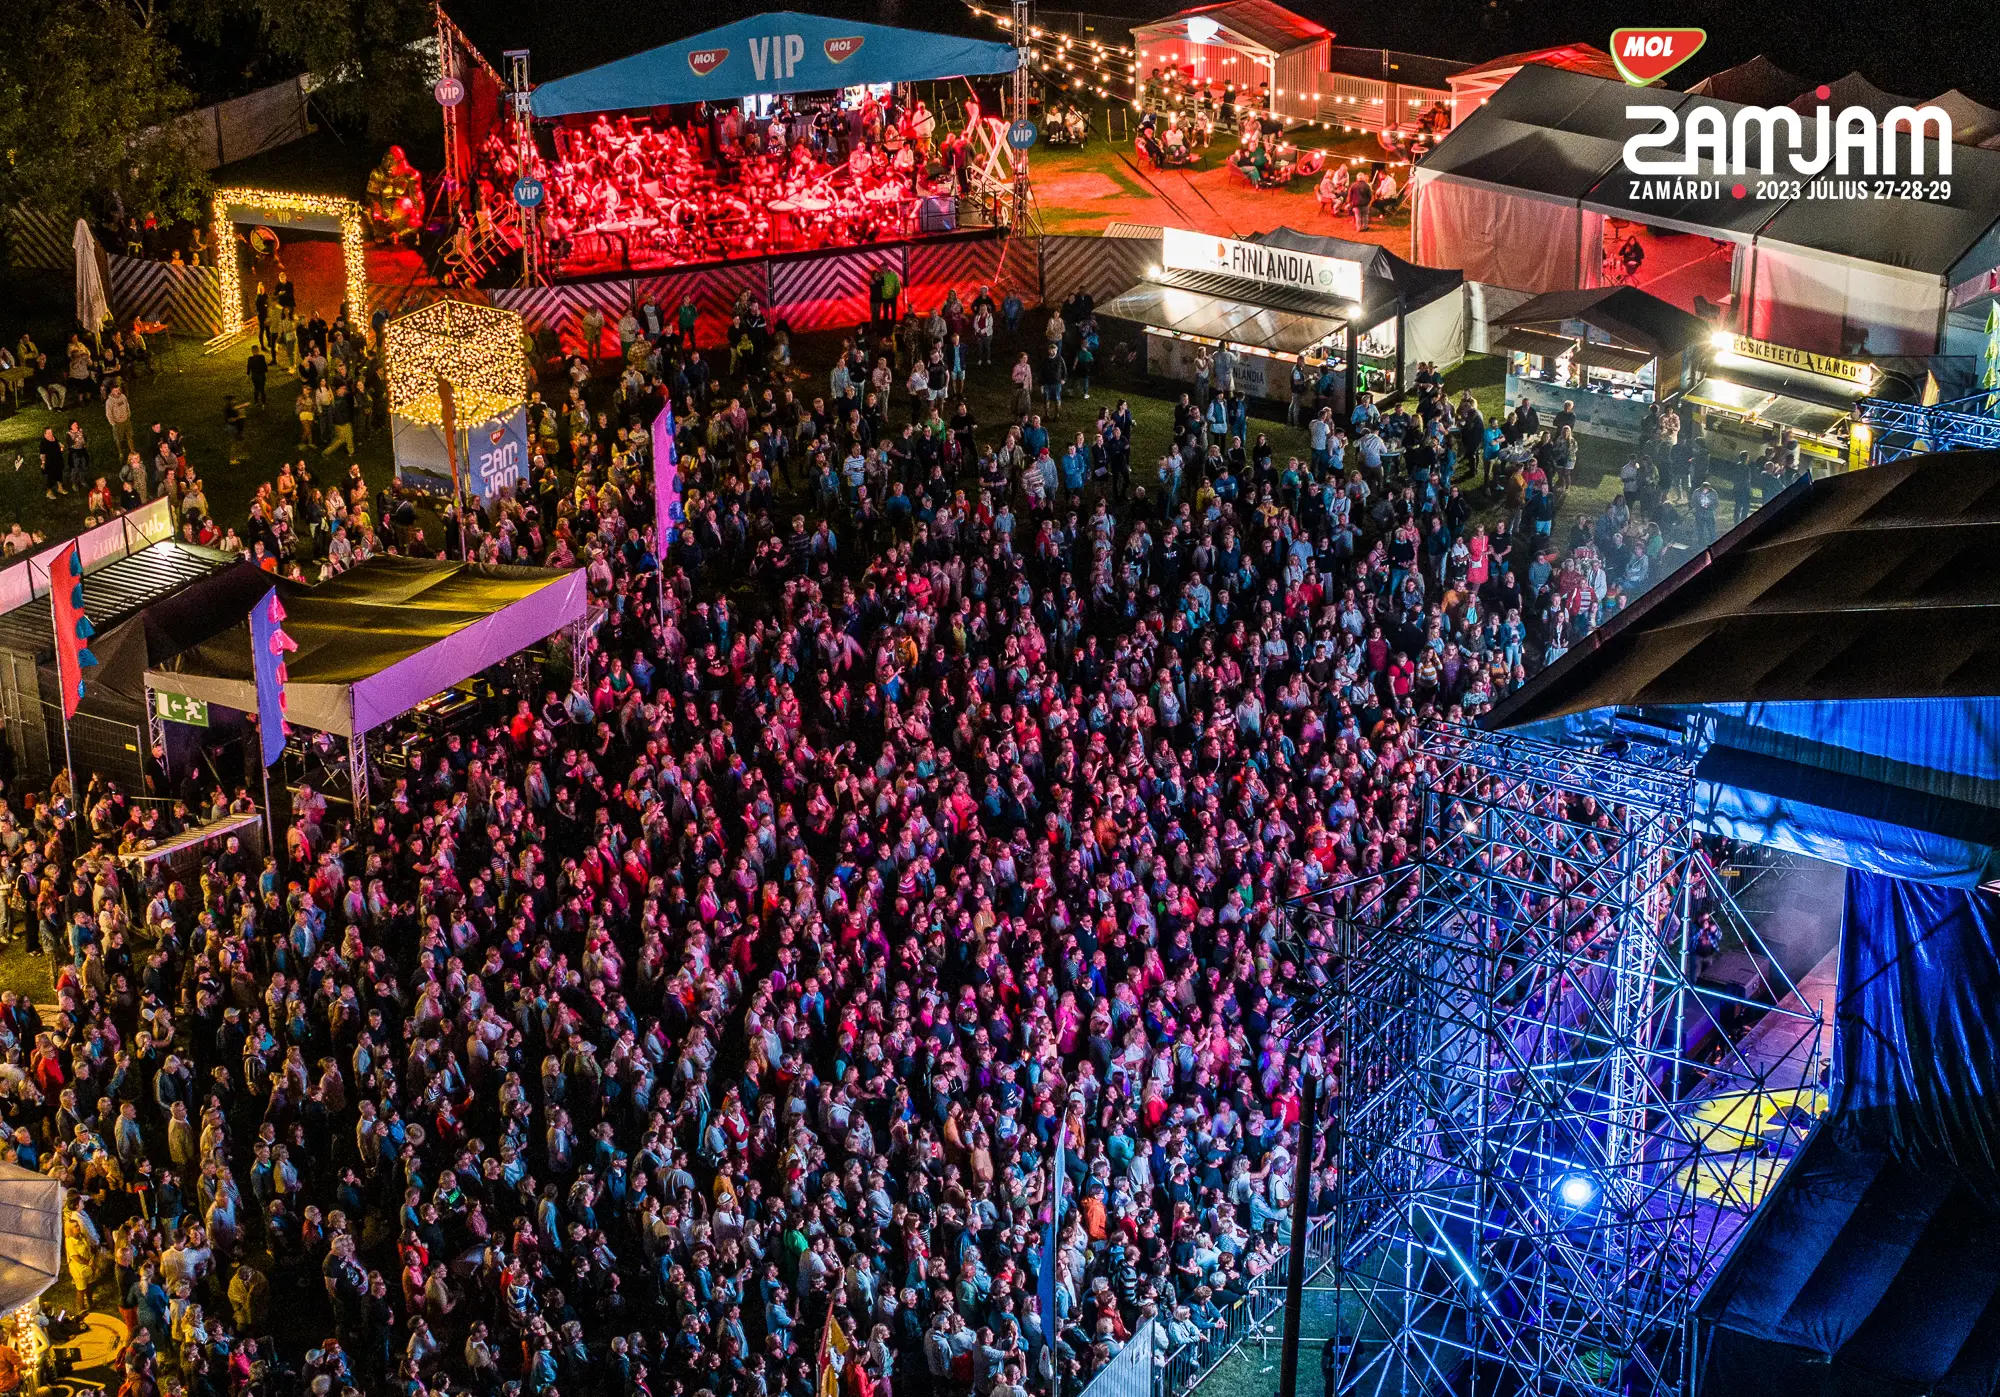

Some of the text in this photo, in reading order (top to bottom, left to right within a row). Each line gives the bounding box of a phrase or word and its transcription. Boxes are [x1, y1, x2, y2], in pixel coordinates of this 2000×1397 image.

[830, 40, 851, 51] MOL
[694, 53, 715, 64] MOL
[749, 34, 804, 80] VIP
[440, 87, 459, 100] VIP
[1013, 130, 1032, 142] VIP
[519, 187, 539, 200] VIP
[277, 211, 292, 224] VIP
[1233, 246, 1314, 285] FINLANDIA
[1232, 367, 1265, 384] NLANDIA
